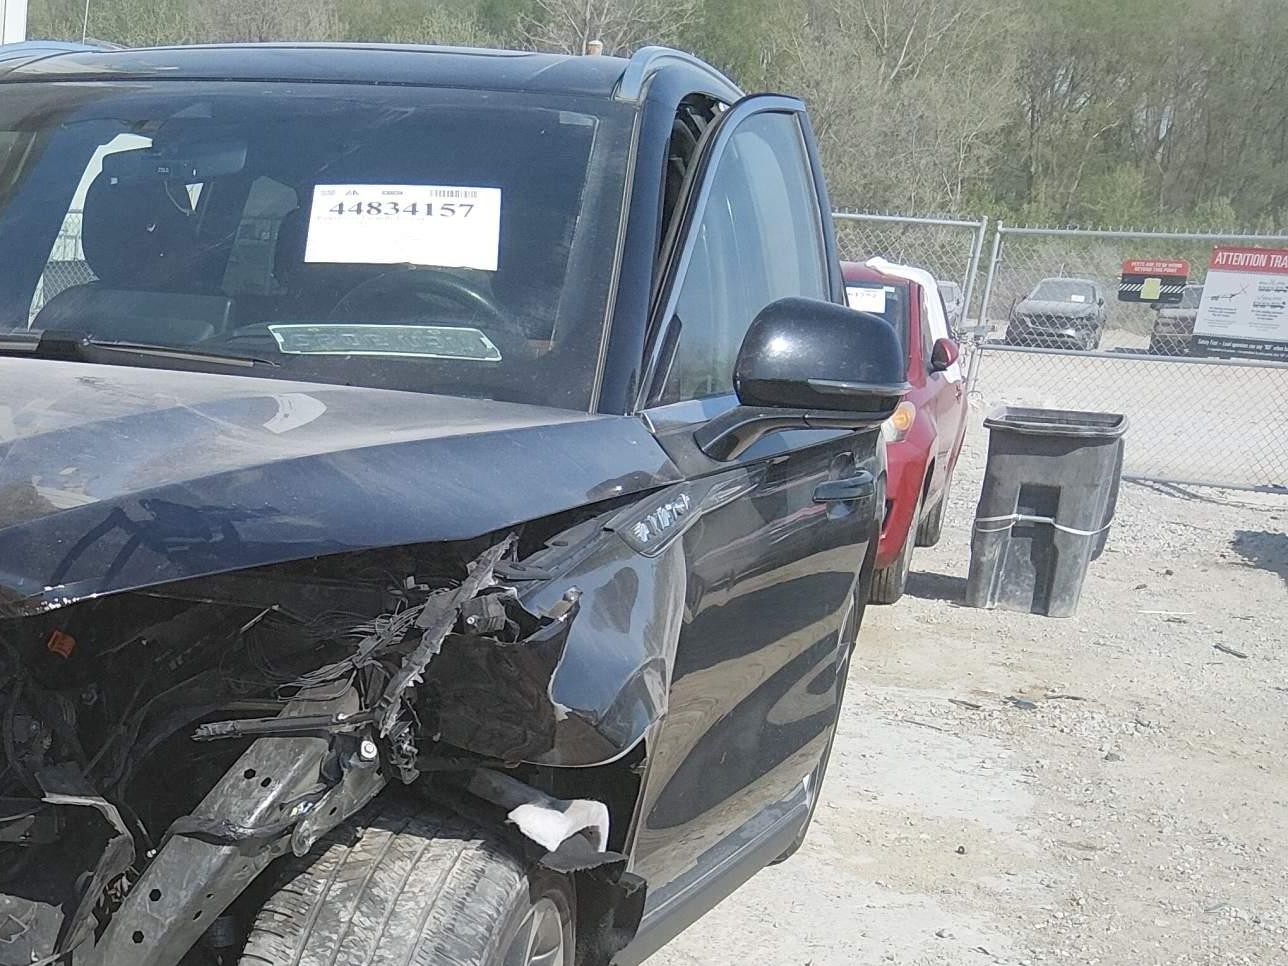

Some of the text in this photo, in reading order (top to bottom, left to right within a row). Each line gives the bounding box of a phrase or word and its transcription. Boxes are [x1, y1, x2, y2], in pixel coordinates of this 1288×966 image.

[329, 202, 475, 218] 44834157
[1214, 252, 1288, 269] ATTENTION TRA
